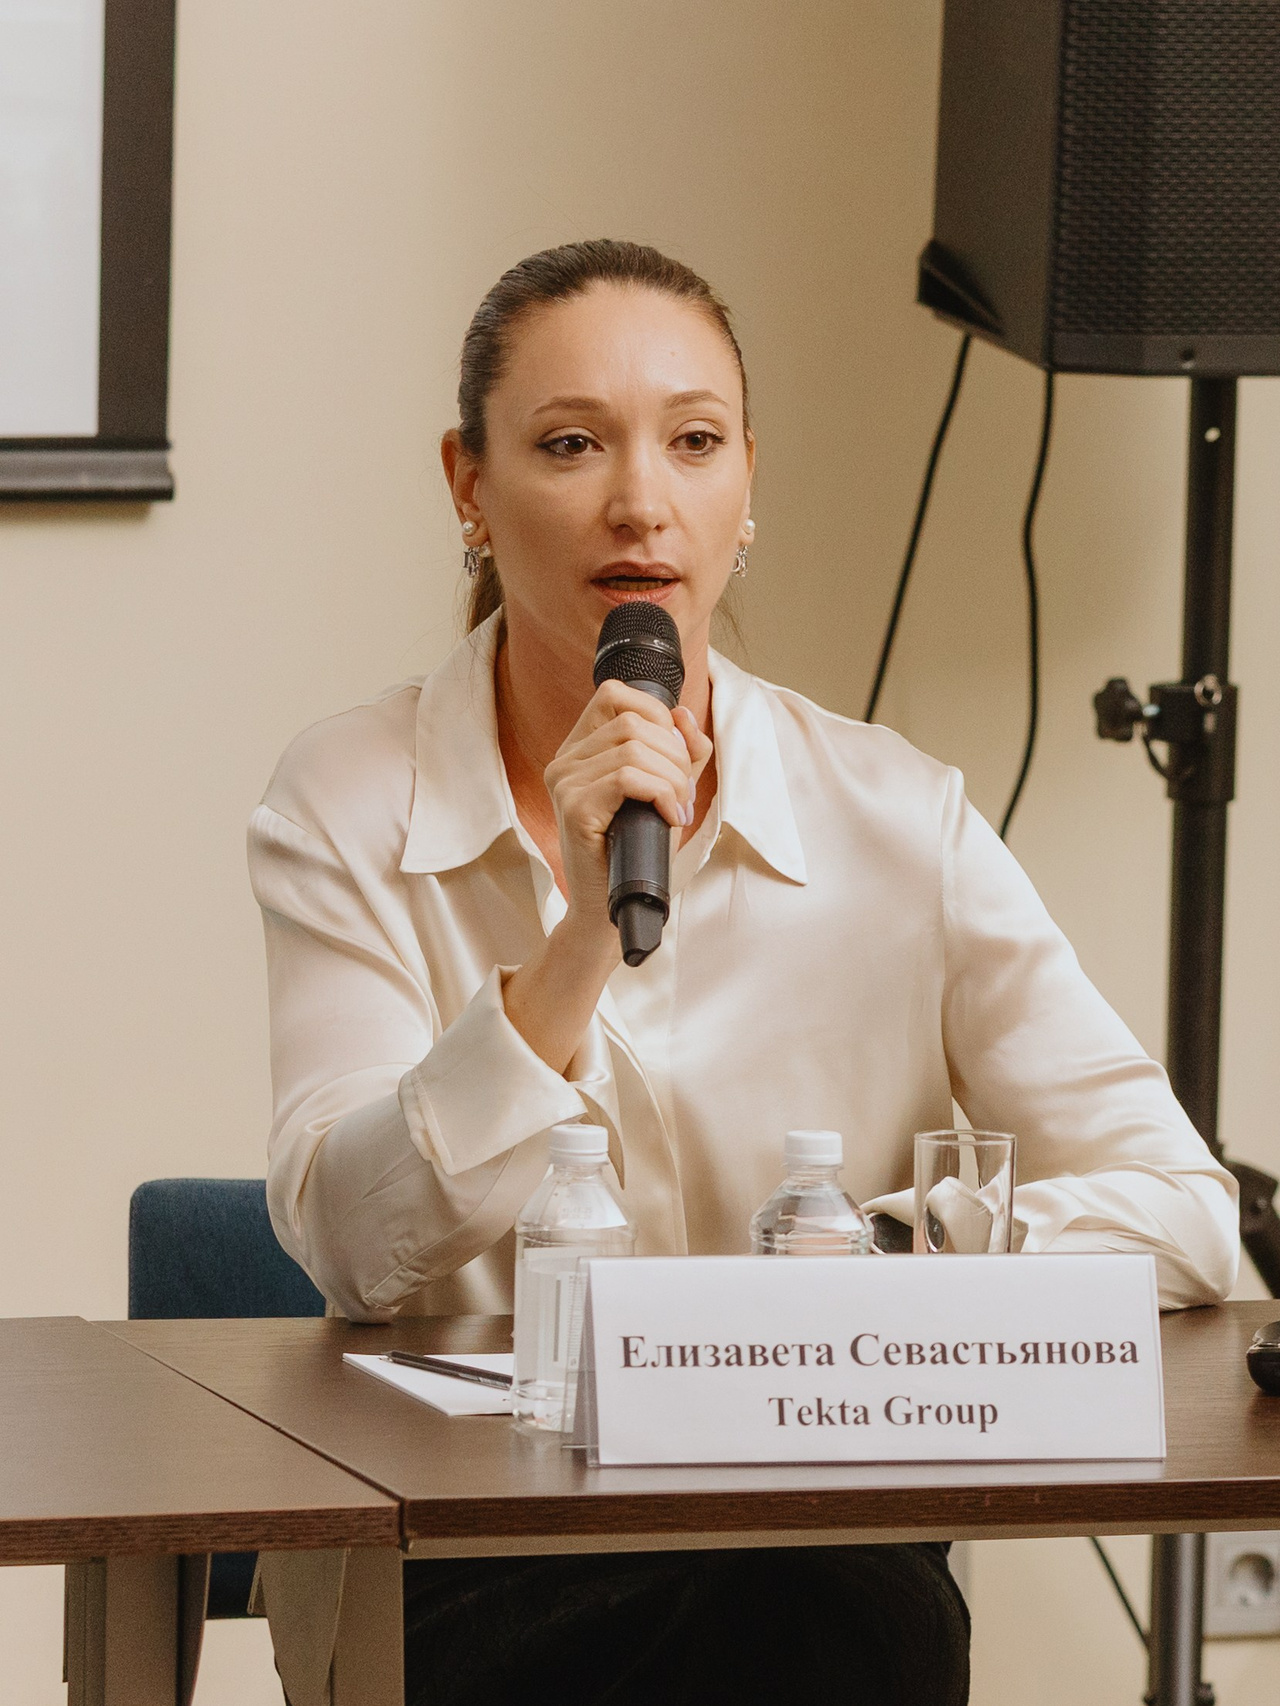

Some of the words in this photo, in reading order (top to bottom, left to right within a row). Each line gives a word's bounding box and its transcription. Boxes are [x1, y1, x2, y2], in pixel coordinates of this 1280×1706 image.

[621, 1336, 835, 1368] Елизавета
[849, 1333, 1139, 1367] Севастьянова
[768, 1397, 870, 1427] Tekta
[884, 1396, 998, 1433] Group
